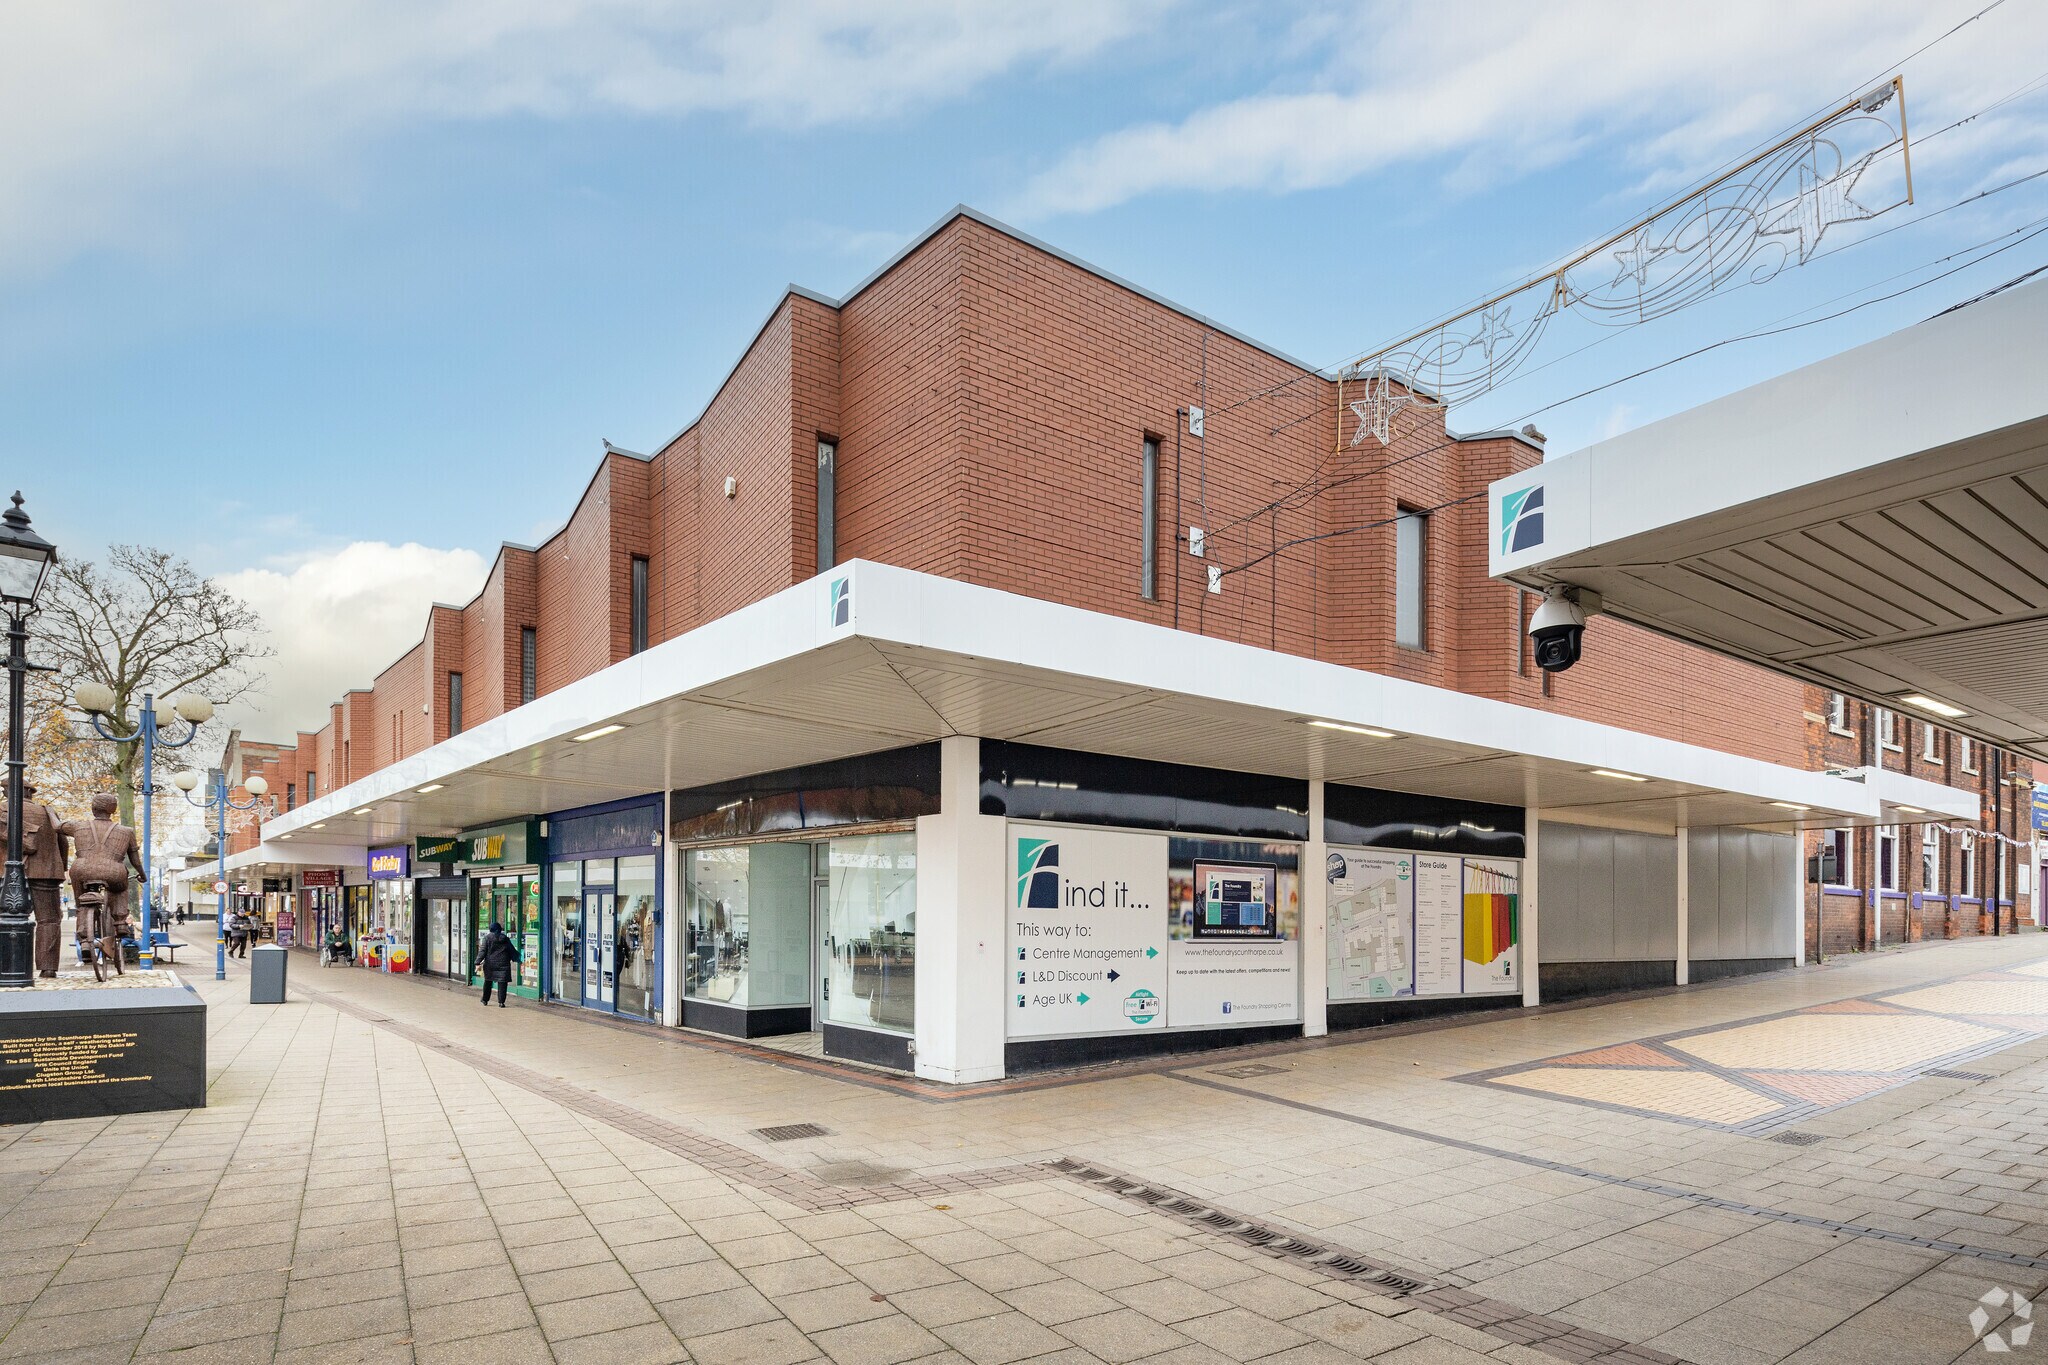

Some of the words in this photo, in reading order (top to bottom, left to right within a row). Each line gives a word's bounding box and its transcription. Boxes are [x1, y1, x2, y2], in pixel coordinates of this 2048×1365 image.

[419, 841, 455, 858] SUBWAY
[472, 834, 505, 862] SUBWAY
[1327, 859, 1344, 872] shop
[1433, 861, 1447, 869] Guide
[1016, 922, 1040, 937] This
[1043, 926, 1072, 939] way
[1076, 924, 1091, 937] to:
[1033, 948, 1070, 960] Centre
[1073, 948, 1142, 961] Management
[1185, 948, 1283, 957] www.thefoundryscunthorpe.co.uk
[1033, 970, 1055, 982] L&D
[1058, 970, 1103, 982] Discount
[1032, 994, 1055, 1007] Age
[1058, 993, 1072, 1004] UK
